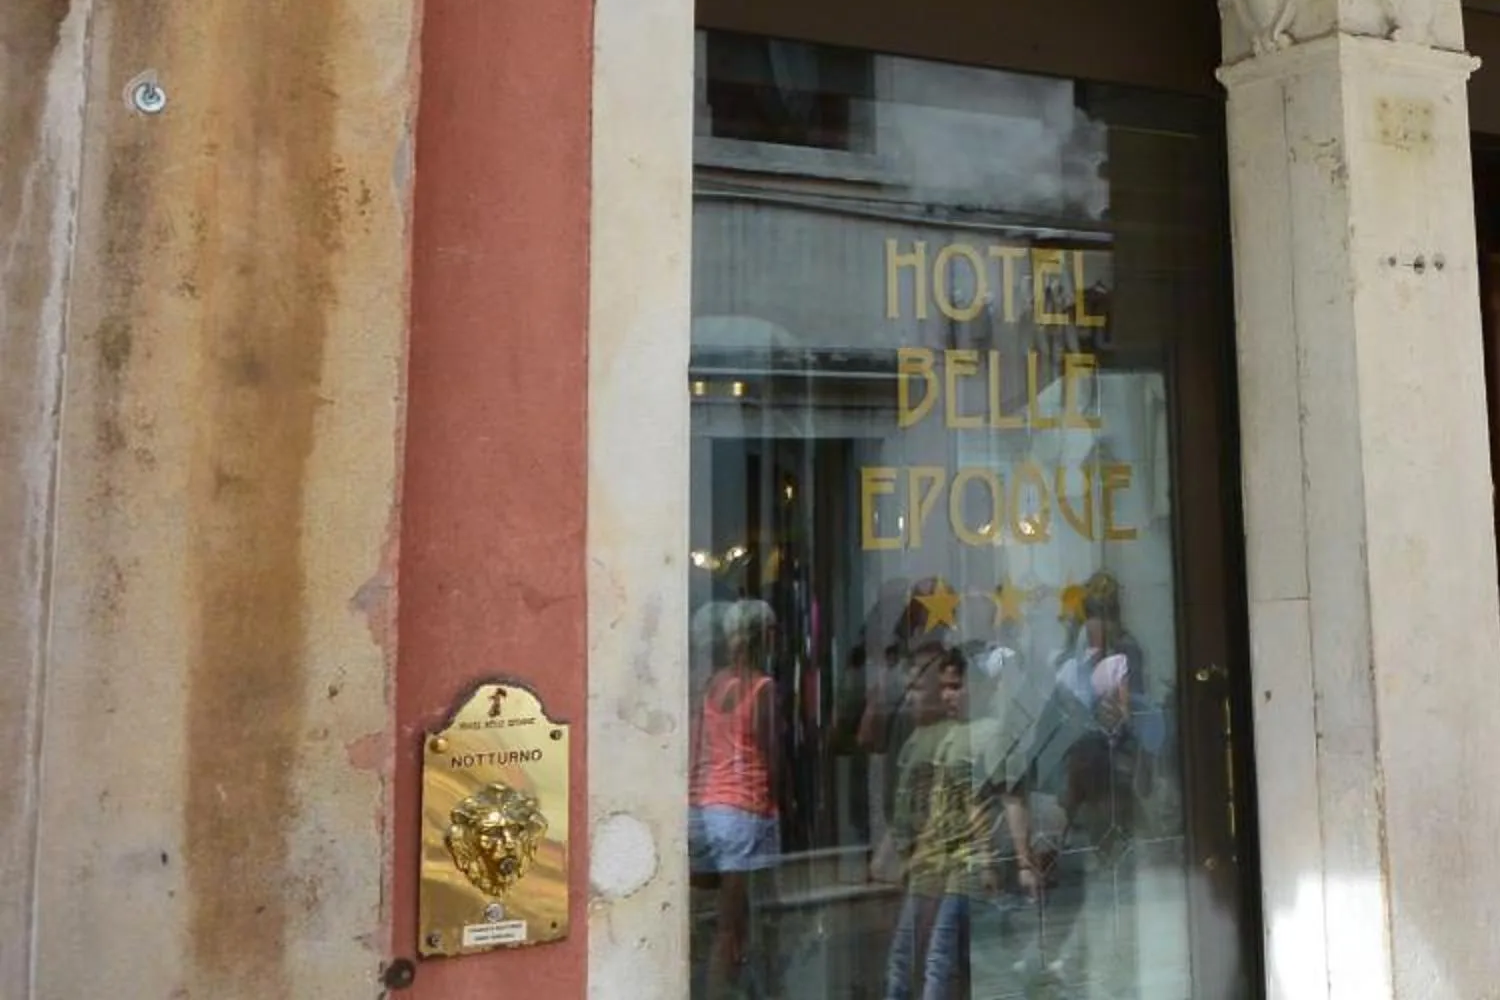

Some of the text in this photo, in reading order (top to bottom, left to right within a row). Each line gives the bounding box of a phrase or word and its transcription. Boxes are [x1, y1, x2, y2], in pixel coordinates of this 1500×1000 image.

[885, 238, 1106, 327] HOTEL
[897, 347, 1105, 430] BELLE
[451, 749, 543, 769] NOTTURNO
